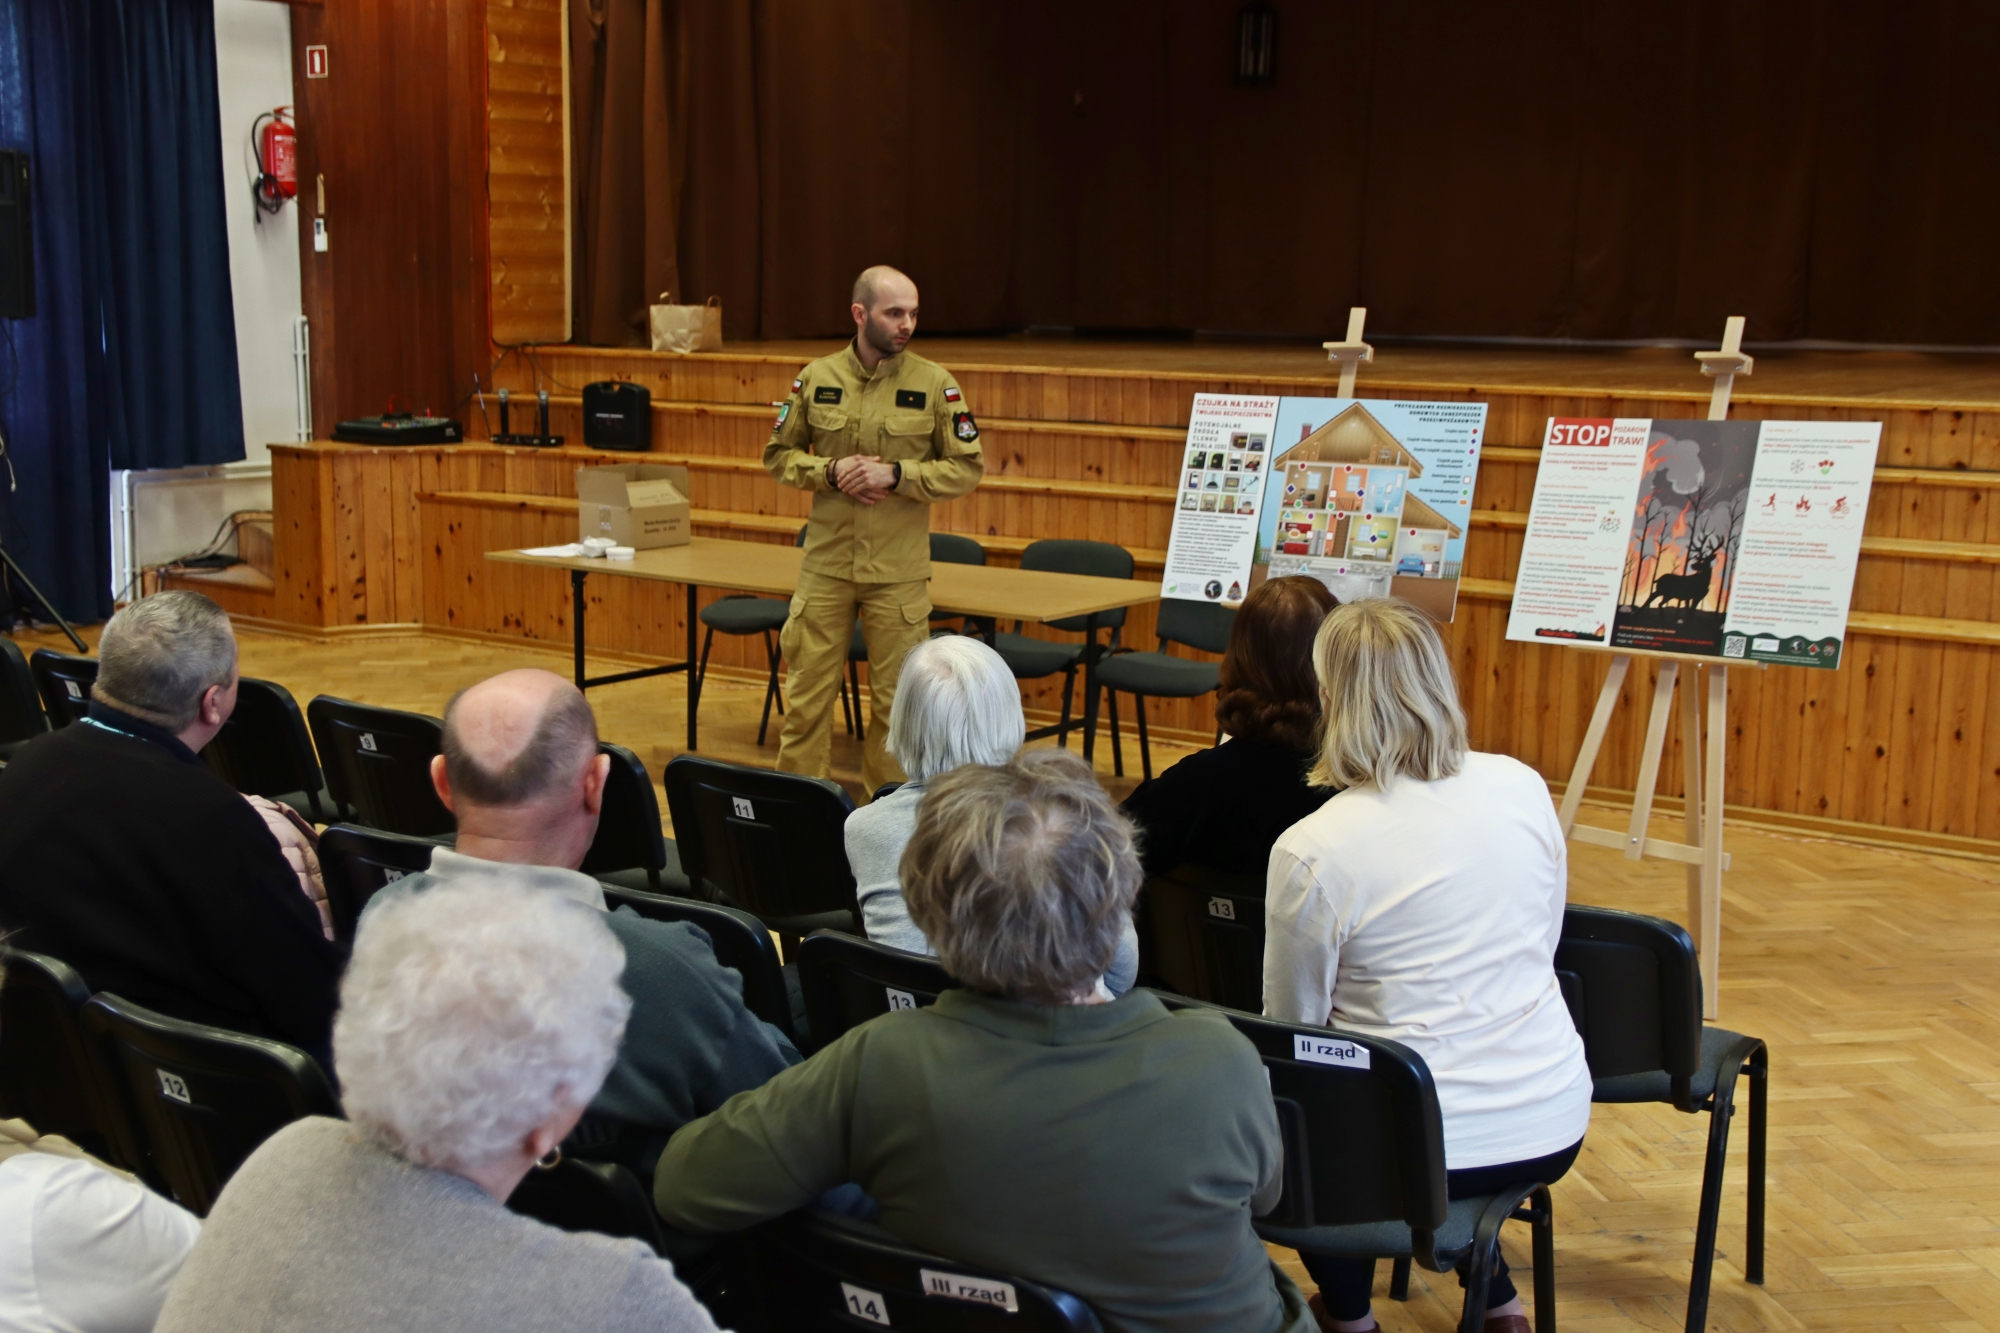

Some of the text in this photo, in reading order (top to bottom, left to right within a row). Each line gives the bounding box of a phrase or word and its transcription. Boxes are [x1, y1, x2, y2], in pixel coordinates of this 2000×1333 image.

[1196, 398, 1275, 409] CZUJKA NA STRAŻY
[1195, 421, 1242, 429] POTENCJALNE
[1550, 423, 1647, 446] STOP POŻAROM
[1612, 436, 1645, 446] TRAW!
[364, 737, 371, 749] 9
[735, 803, 750, 818] 11
[1211, 901, 1231, 917] 13
[891, 994, 912, 1011] 13
[1301, 1040, 1356, 1060] II rząd
[165, 1077, 187, 1099] 12
[931, 1277, 951, 1293] III
[849, 1294, 881, 1321] 14
